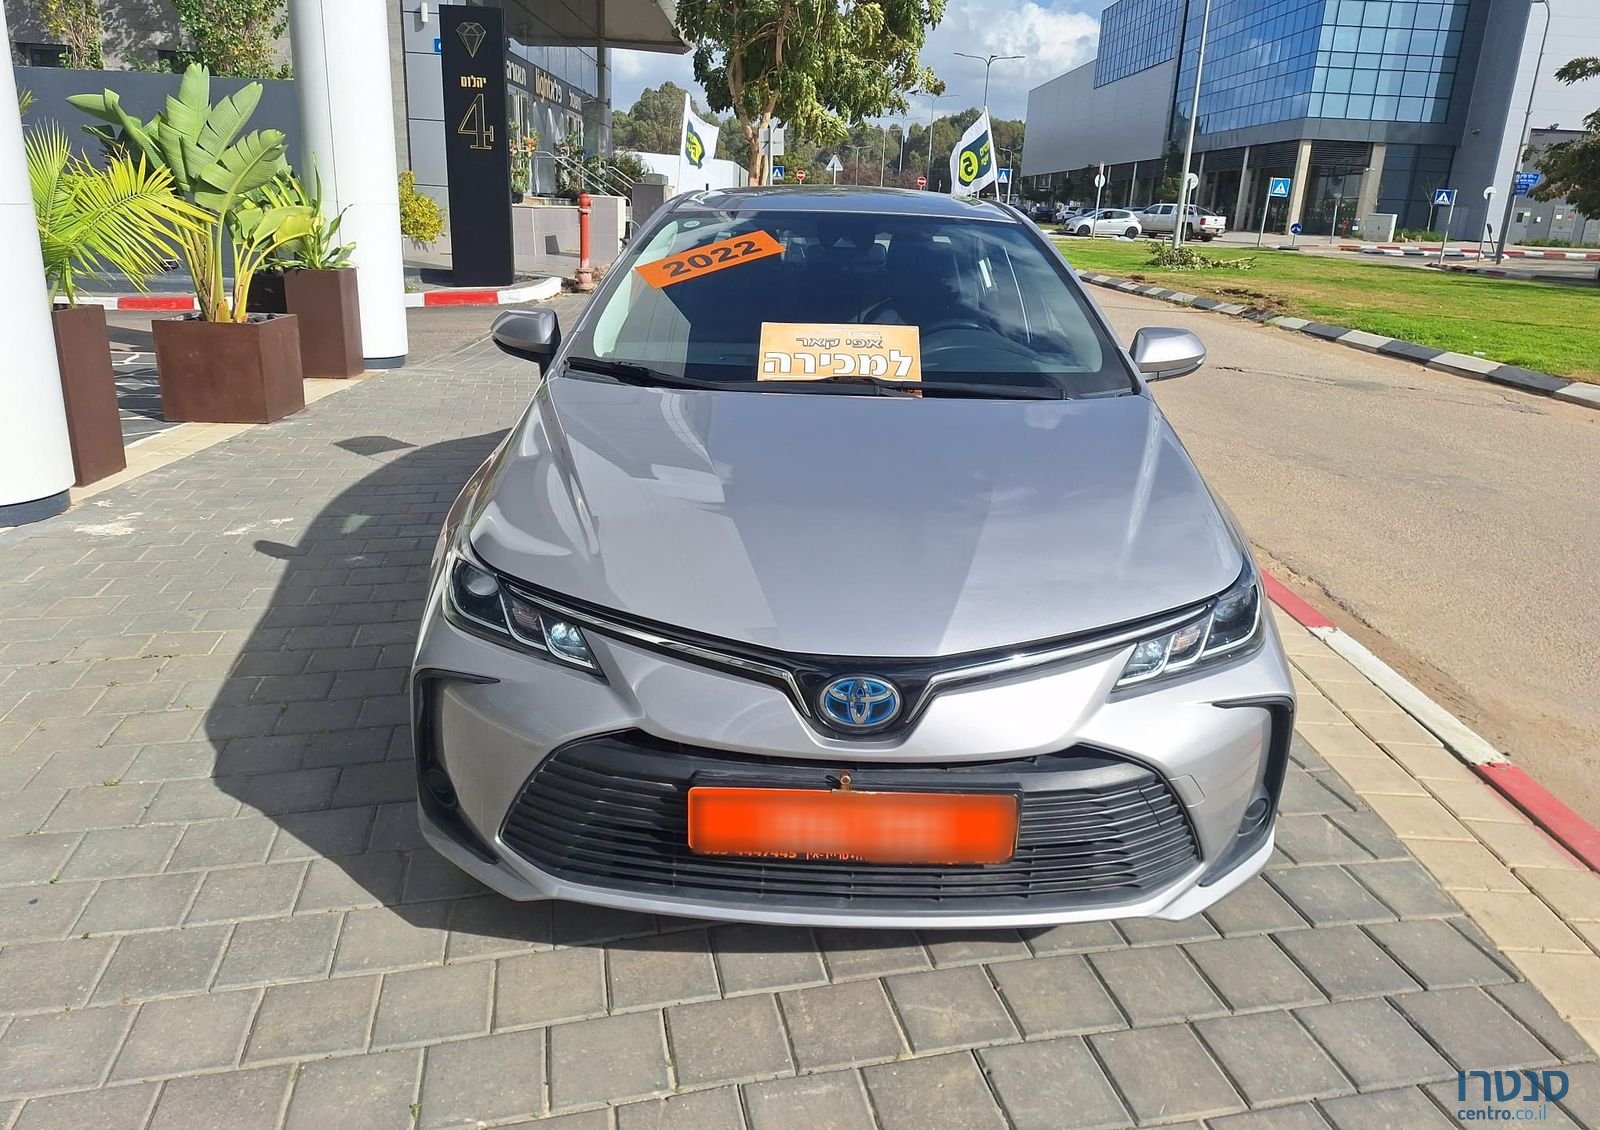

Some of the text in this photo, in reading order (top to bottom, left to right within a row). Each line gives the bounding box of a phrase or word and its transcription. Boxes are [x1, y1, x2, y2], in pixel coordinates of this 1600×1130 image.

[460, 75, 487, 88] יהלום
[458, 93, 494, 150] 4
[663, 240, 762, 278] 2022
[796, 337, 883, 350] אפי קאר
[763, 349, 913, 378] למכירה
